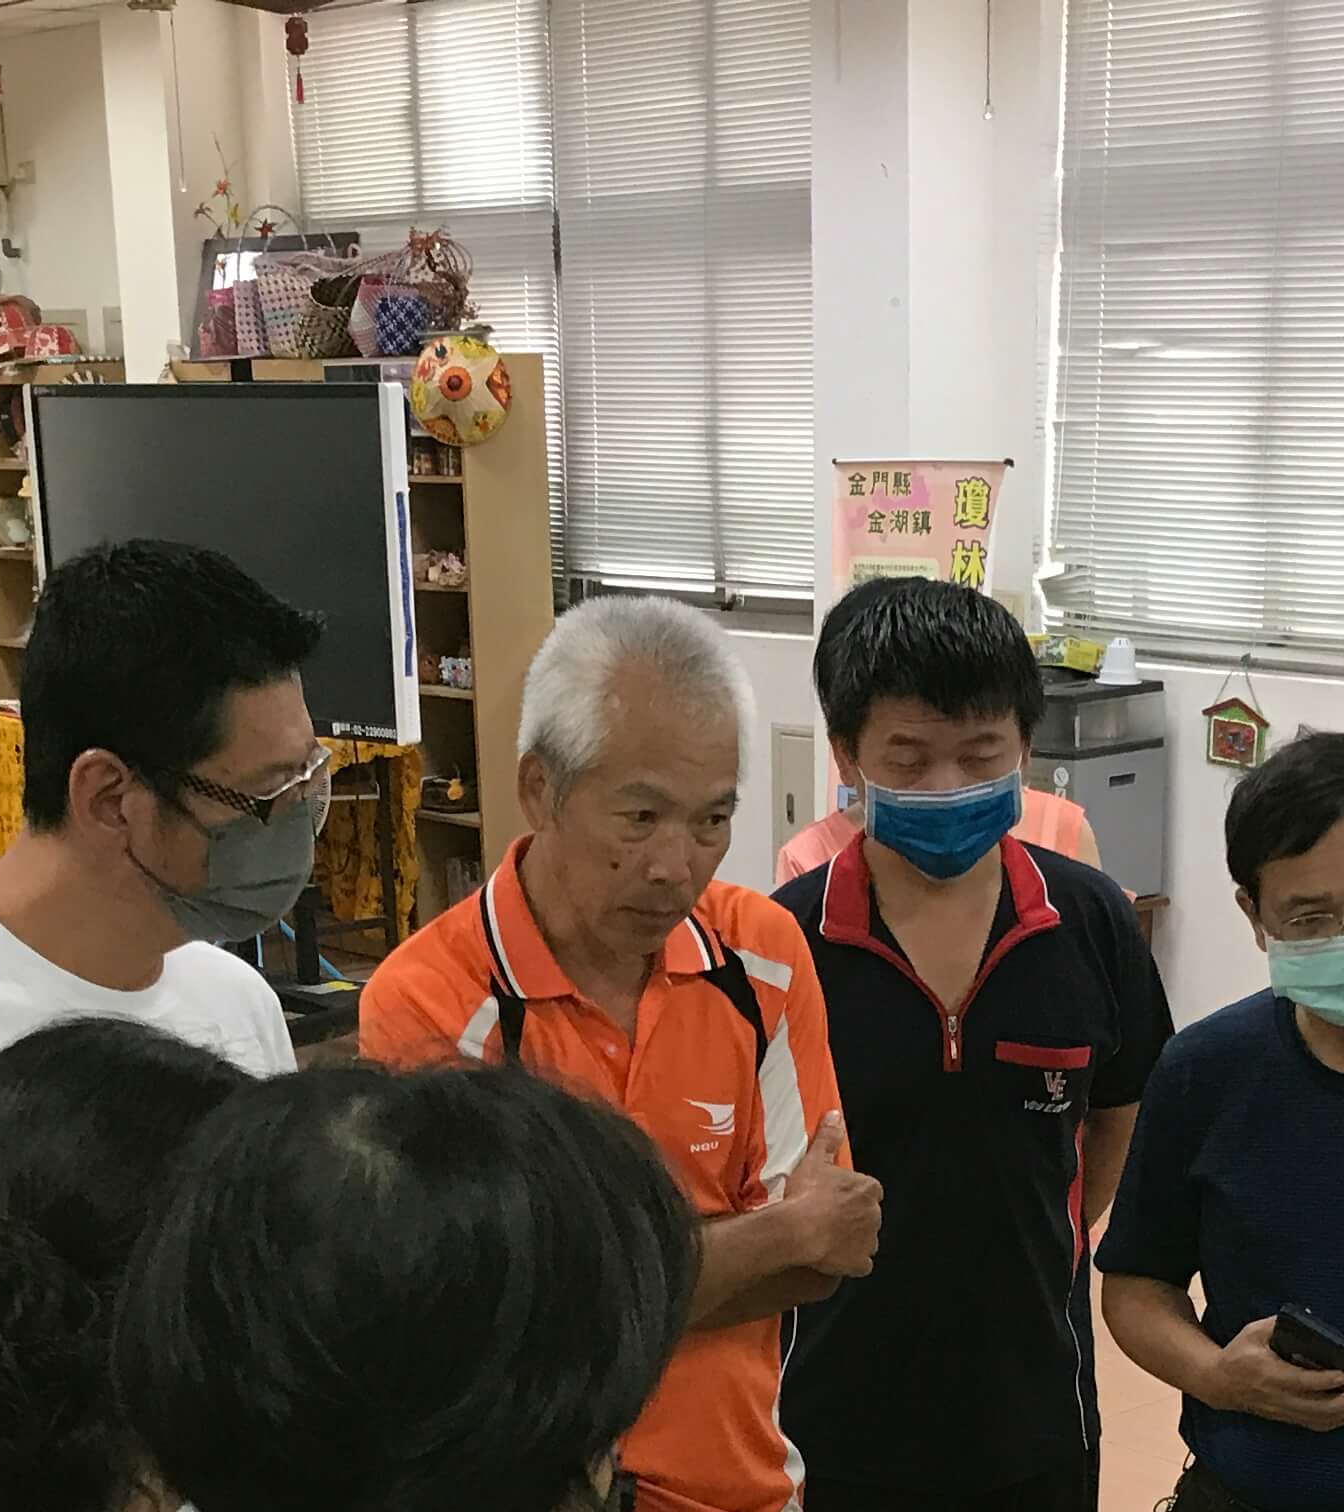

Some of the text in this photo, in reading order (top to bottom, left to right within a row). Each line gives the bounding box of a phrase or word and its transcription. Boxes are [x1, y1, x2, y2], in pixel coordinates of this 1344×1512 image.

[848, 471, 912, 497] 金門縣
[867, 510, 932, 535] 金湖鎮
[950, 476, 991, 593] 瓊林
[689, 1140, 720, 1153] NQU
